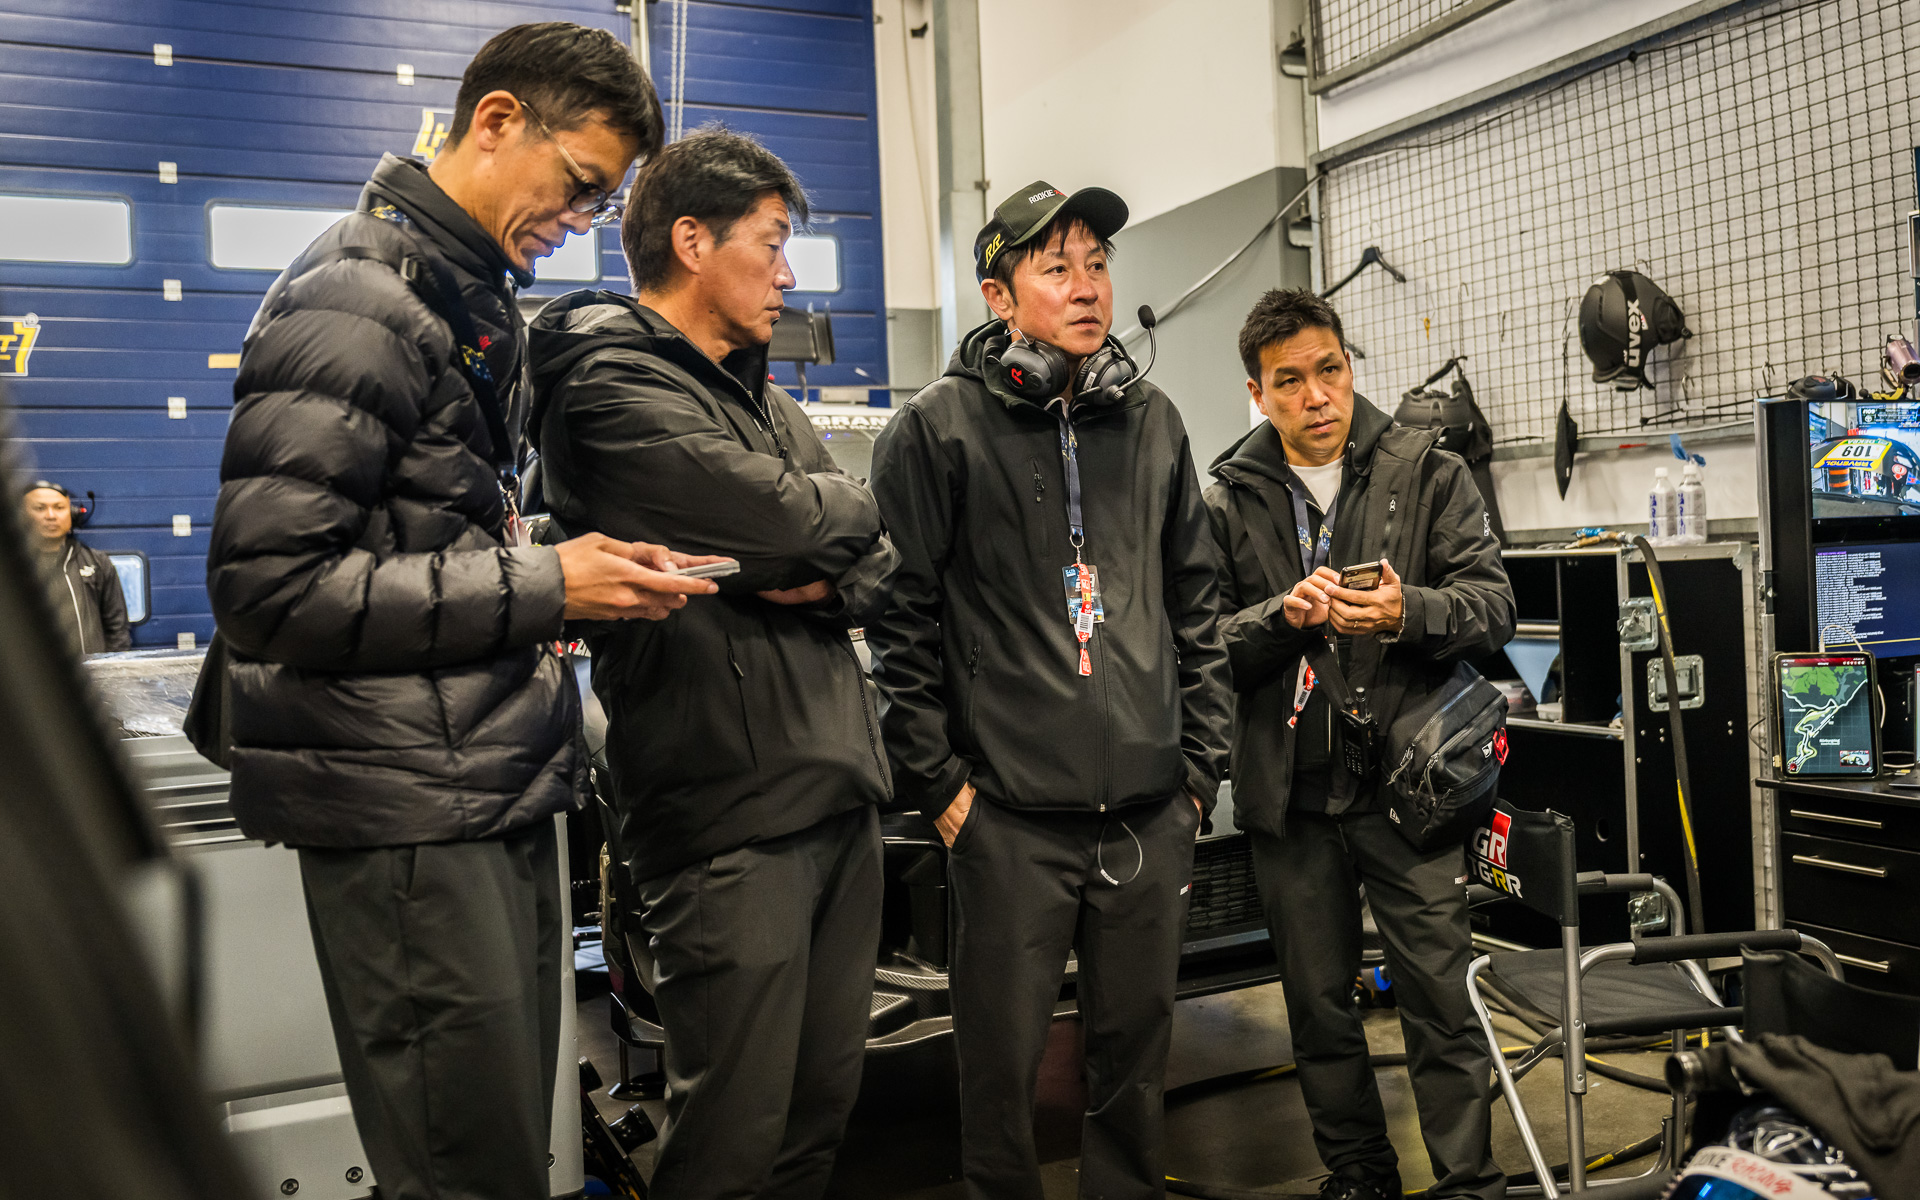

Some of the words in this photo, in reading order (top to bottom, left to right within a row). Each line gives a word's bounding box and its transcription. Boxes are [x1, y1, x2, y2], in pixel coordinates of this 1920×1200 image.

[1028, 189, 1056, 204] ROOKIE
[1626, 298, 1641, 368] uvex
[1472, 826, 1506, 866] GR
